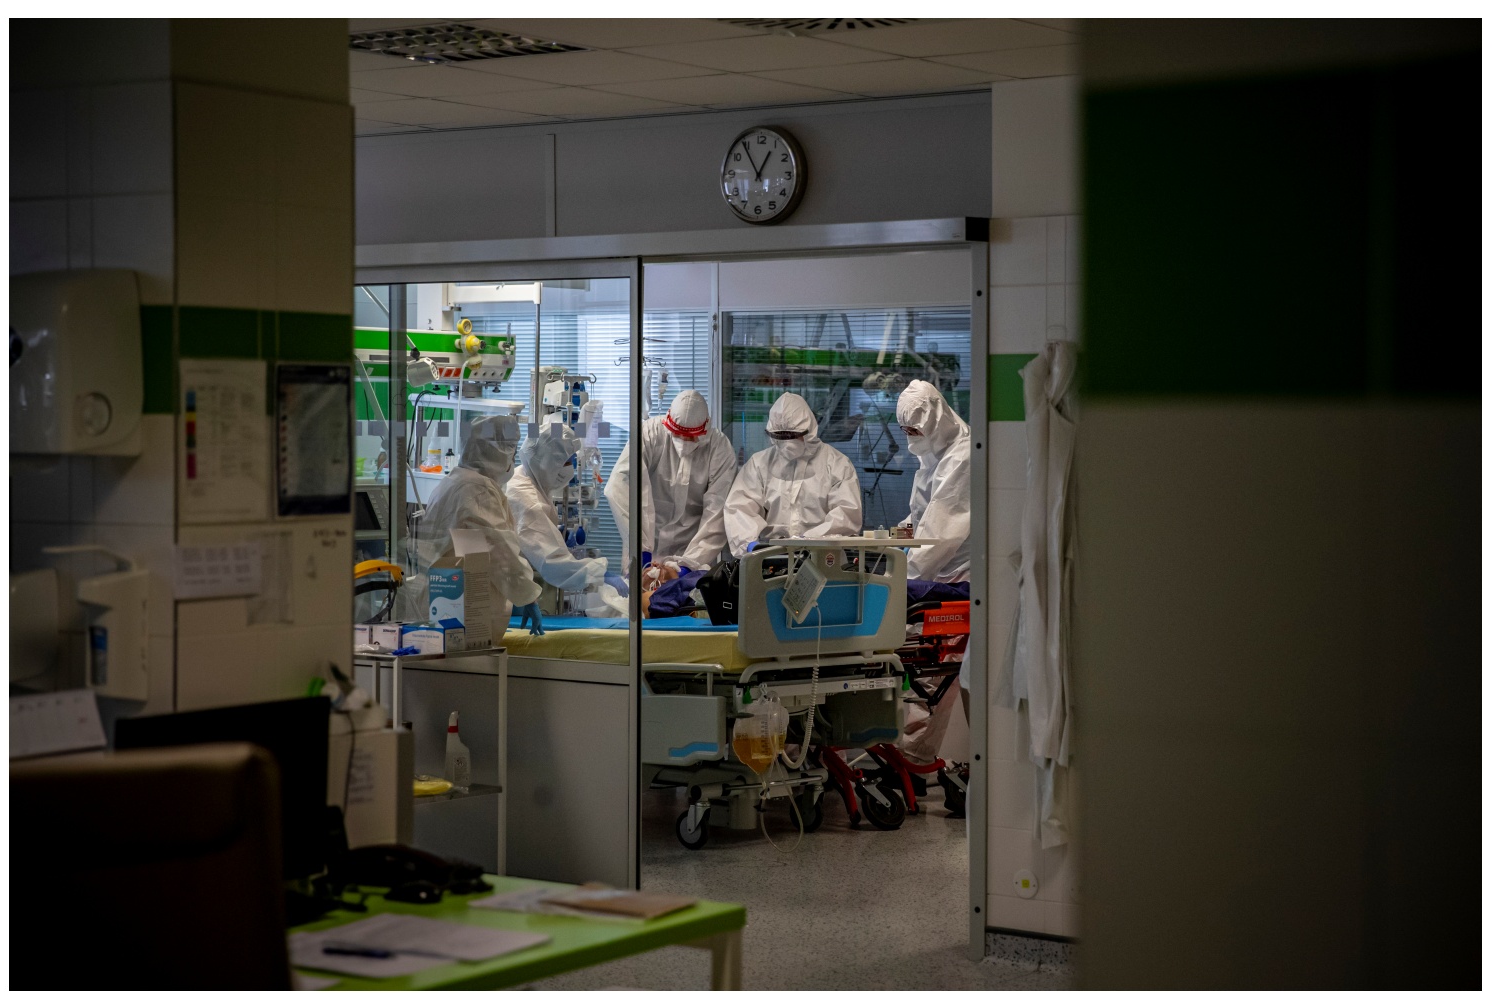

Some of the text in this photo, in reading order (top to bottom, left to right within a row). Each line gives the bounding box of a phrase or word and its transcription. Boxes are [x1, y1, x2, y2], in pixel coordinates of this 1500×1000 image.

[756, 135, 767, 145] 12
[733, 153, 742, 162] 10
[781, 153, 789, 163] 2
[727, 169, 736, 179] 9
[785, 171, 792, 180] 3
[779, 187, 787, 197] 4
[741, 200, 748, 210] 7
[754, 205, 762, 215] 6
[768, 200, 777, 210] 5
[928, 614, 965, 623] MEDIROL
